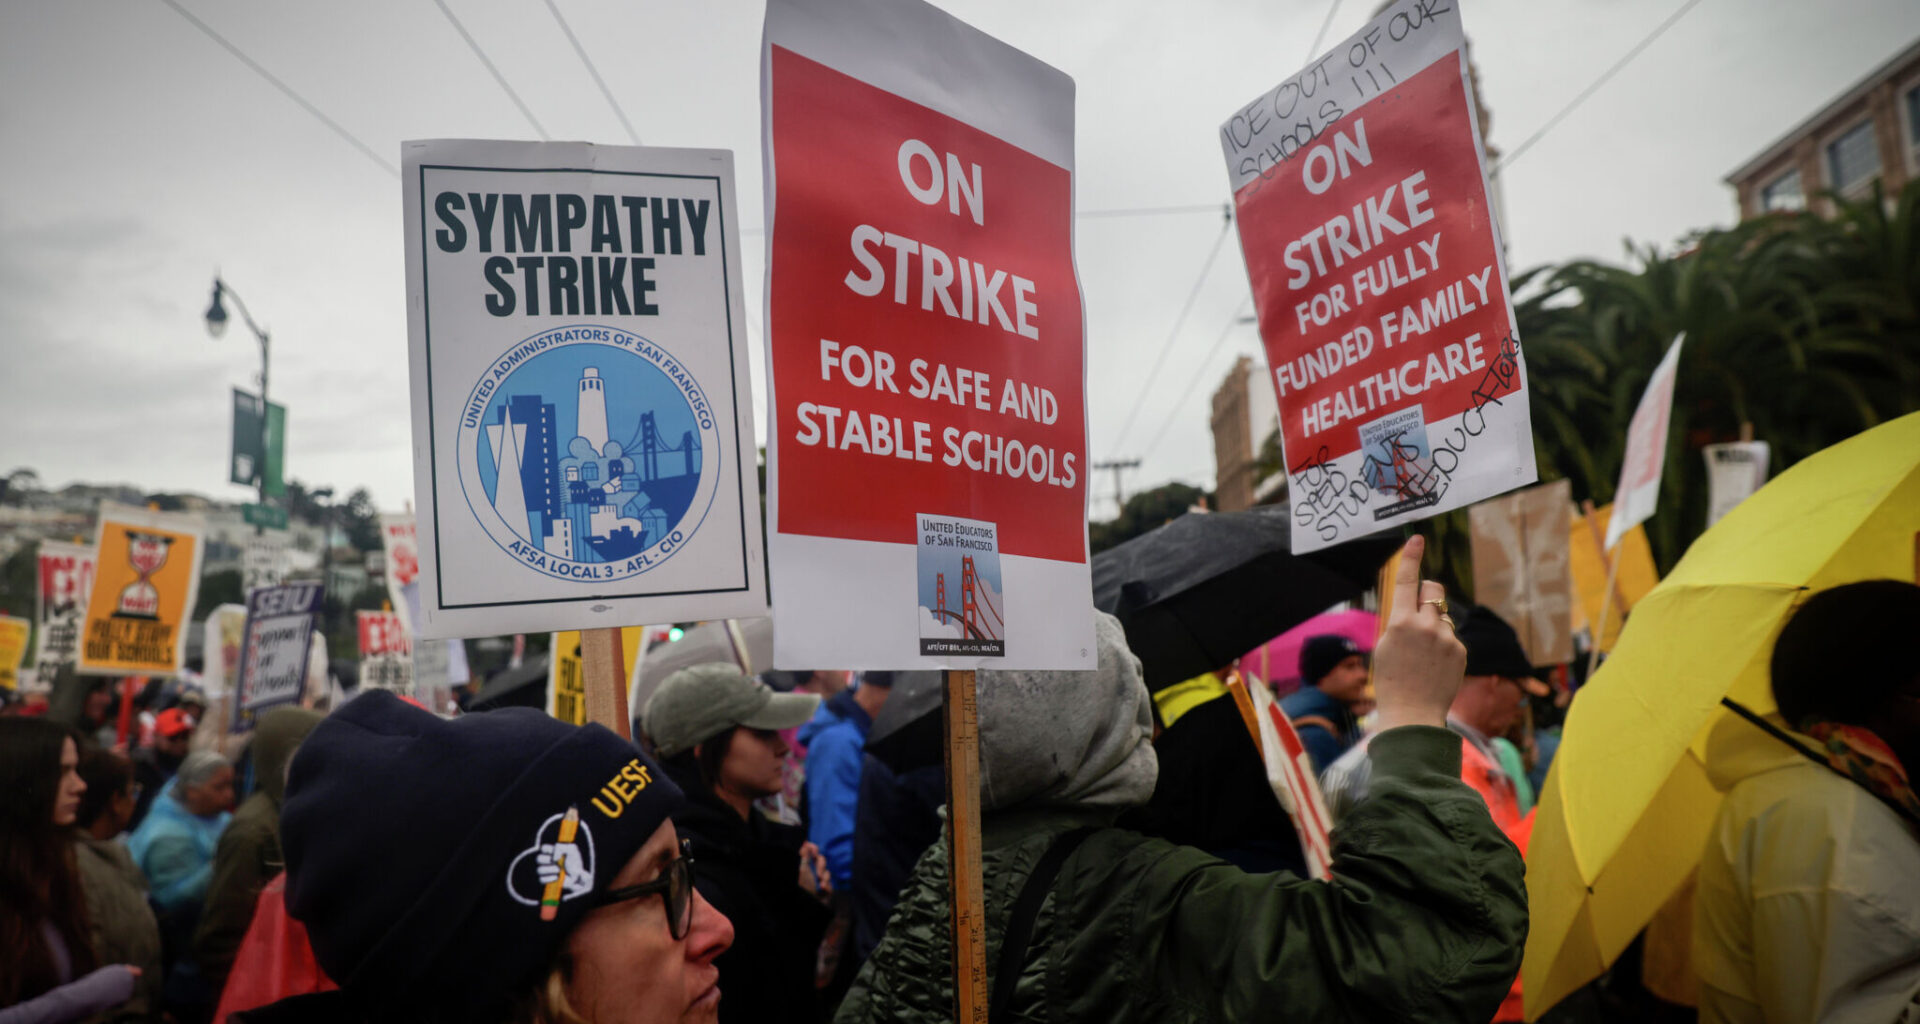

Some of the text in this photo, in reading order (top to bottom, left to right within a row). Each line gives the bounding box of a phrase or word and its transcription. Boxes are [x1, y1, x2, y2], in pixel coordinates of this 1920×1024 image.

[1223, 0, 1450, 153] ICE OUT OF OUR
[897, 139, 984, 226] ON
[1239, 99, 1344, 196] SCHOOLS
[1302, 117, 1373, 195] ON
[434, 191, 711, 256] SYMPATHY
[1283, 170, 1435, 290] STRIKE
[483, 256, 659, 317] STRIKE
[844, 224, 1039, 341] STRIKE
[1295, 232, 1441, 335] FOR FULLY
[1275, 265, 1492, 398] FUNDED FAMILY
[464, 329, 712, 430] UNITED ADMINISTRATORS OF SAN FRANCISCO
[820, 338, 1058, 425] FOR SAFE AND
[1301, 332, 1486, 438] HEALTHCARE
[1383, 411, 1420, 429] EDUCATORS
[795, 401, 1076, 488] STABLE SCHOOLS
[1292, 445, 1336, 492] FOR
[1316, 430, 1420, 542] STUDENTS
[922, 519, 993, 539] UNITED EDUCATORS
[1294, 470, 1347, 527] SPED
[509, 539, 547, 570] AFSA
[550, 560, 602, 579] LOCAL
[604, 565, 614, 578] 3
[626, 552, 653, 573] AFL
[659, 530, 684, 554] CIO
[925, 533, 993, 552] OF SAN FRANCISCO
[591, 758, 652, 819] UESF
